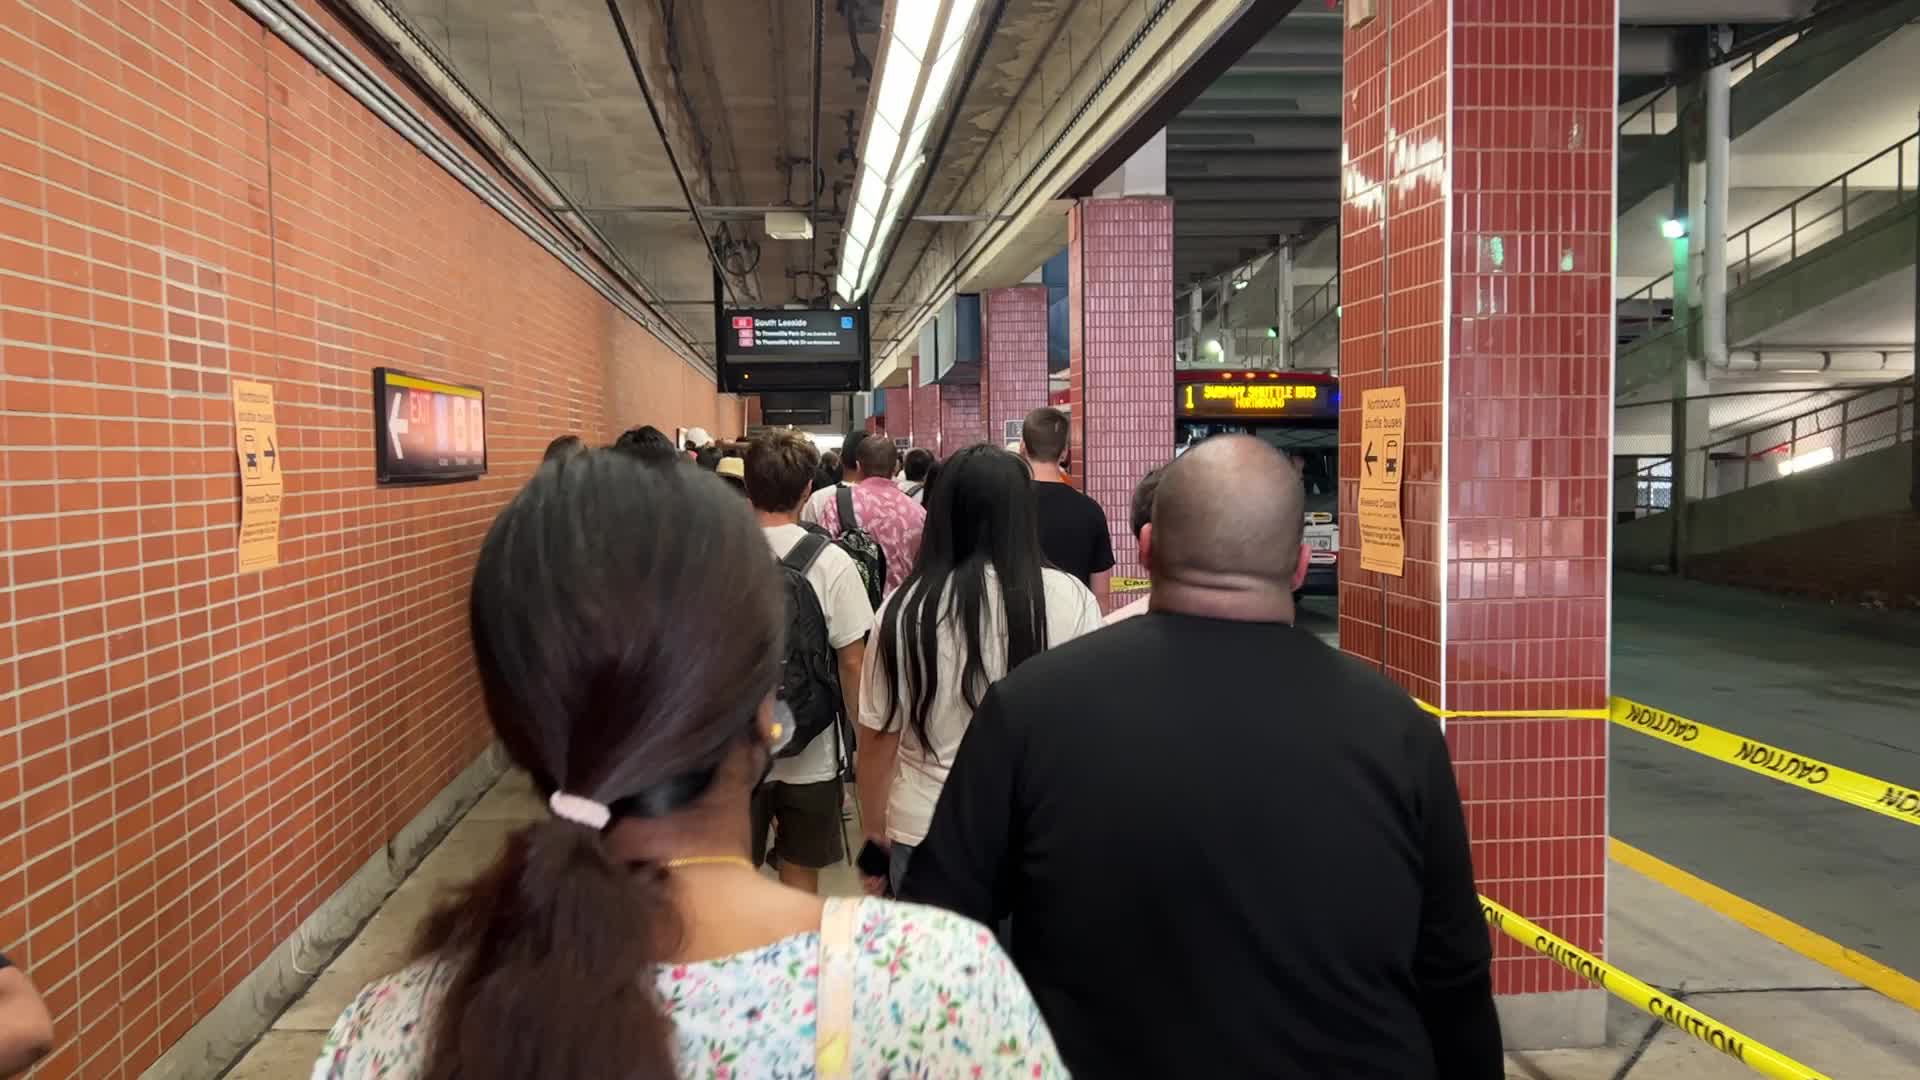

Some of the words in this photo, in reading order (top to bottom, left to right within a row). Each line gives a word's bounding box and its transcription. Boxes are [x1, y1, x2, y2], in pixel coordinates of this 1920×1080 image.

[754, 319, 776, 327] South
[409, 391, 431, 424] EXIT
[1185, 385, 1194, 408] 1
[1247, 385, 1293, 399] SHUTTLE
[1626, 704, 1699, 742] CAUTION
[1734, 741, 1829, 784] CAUTION
[1535, 935, 1607, 987] CAUTION
[1649, 997, 1746, 1063] CAUTION
